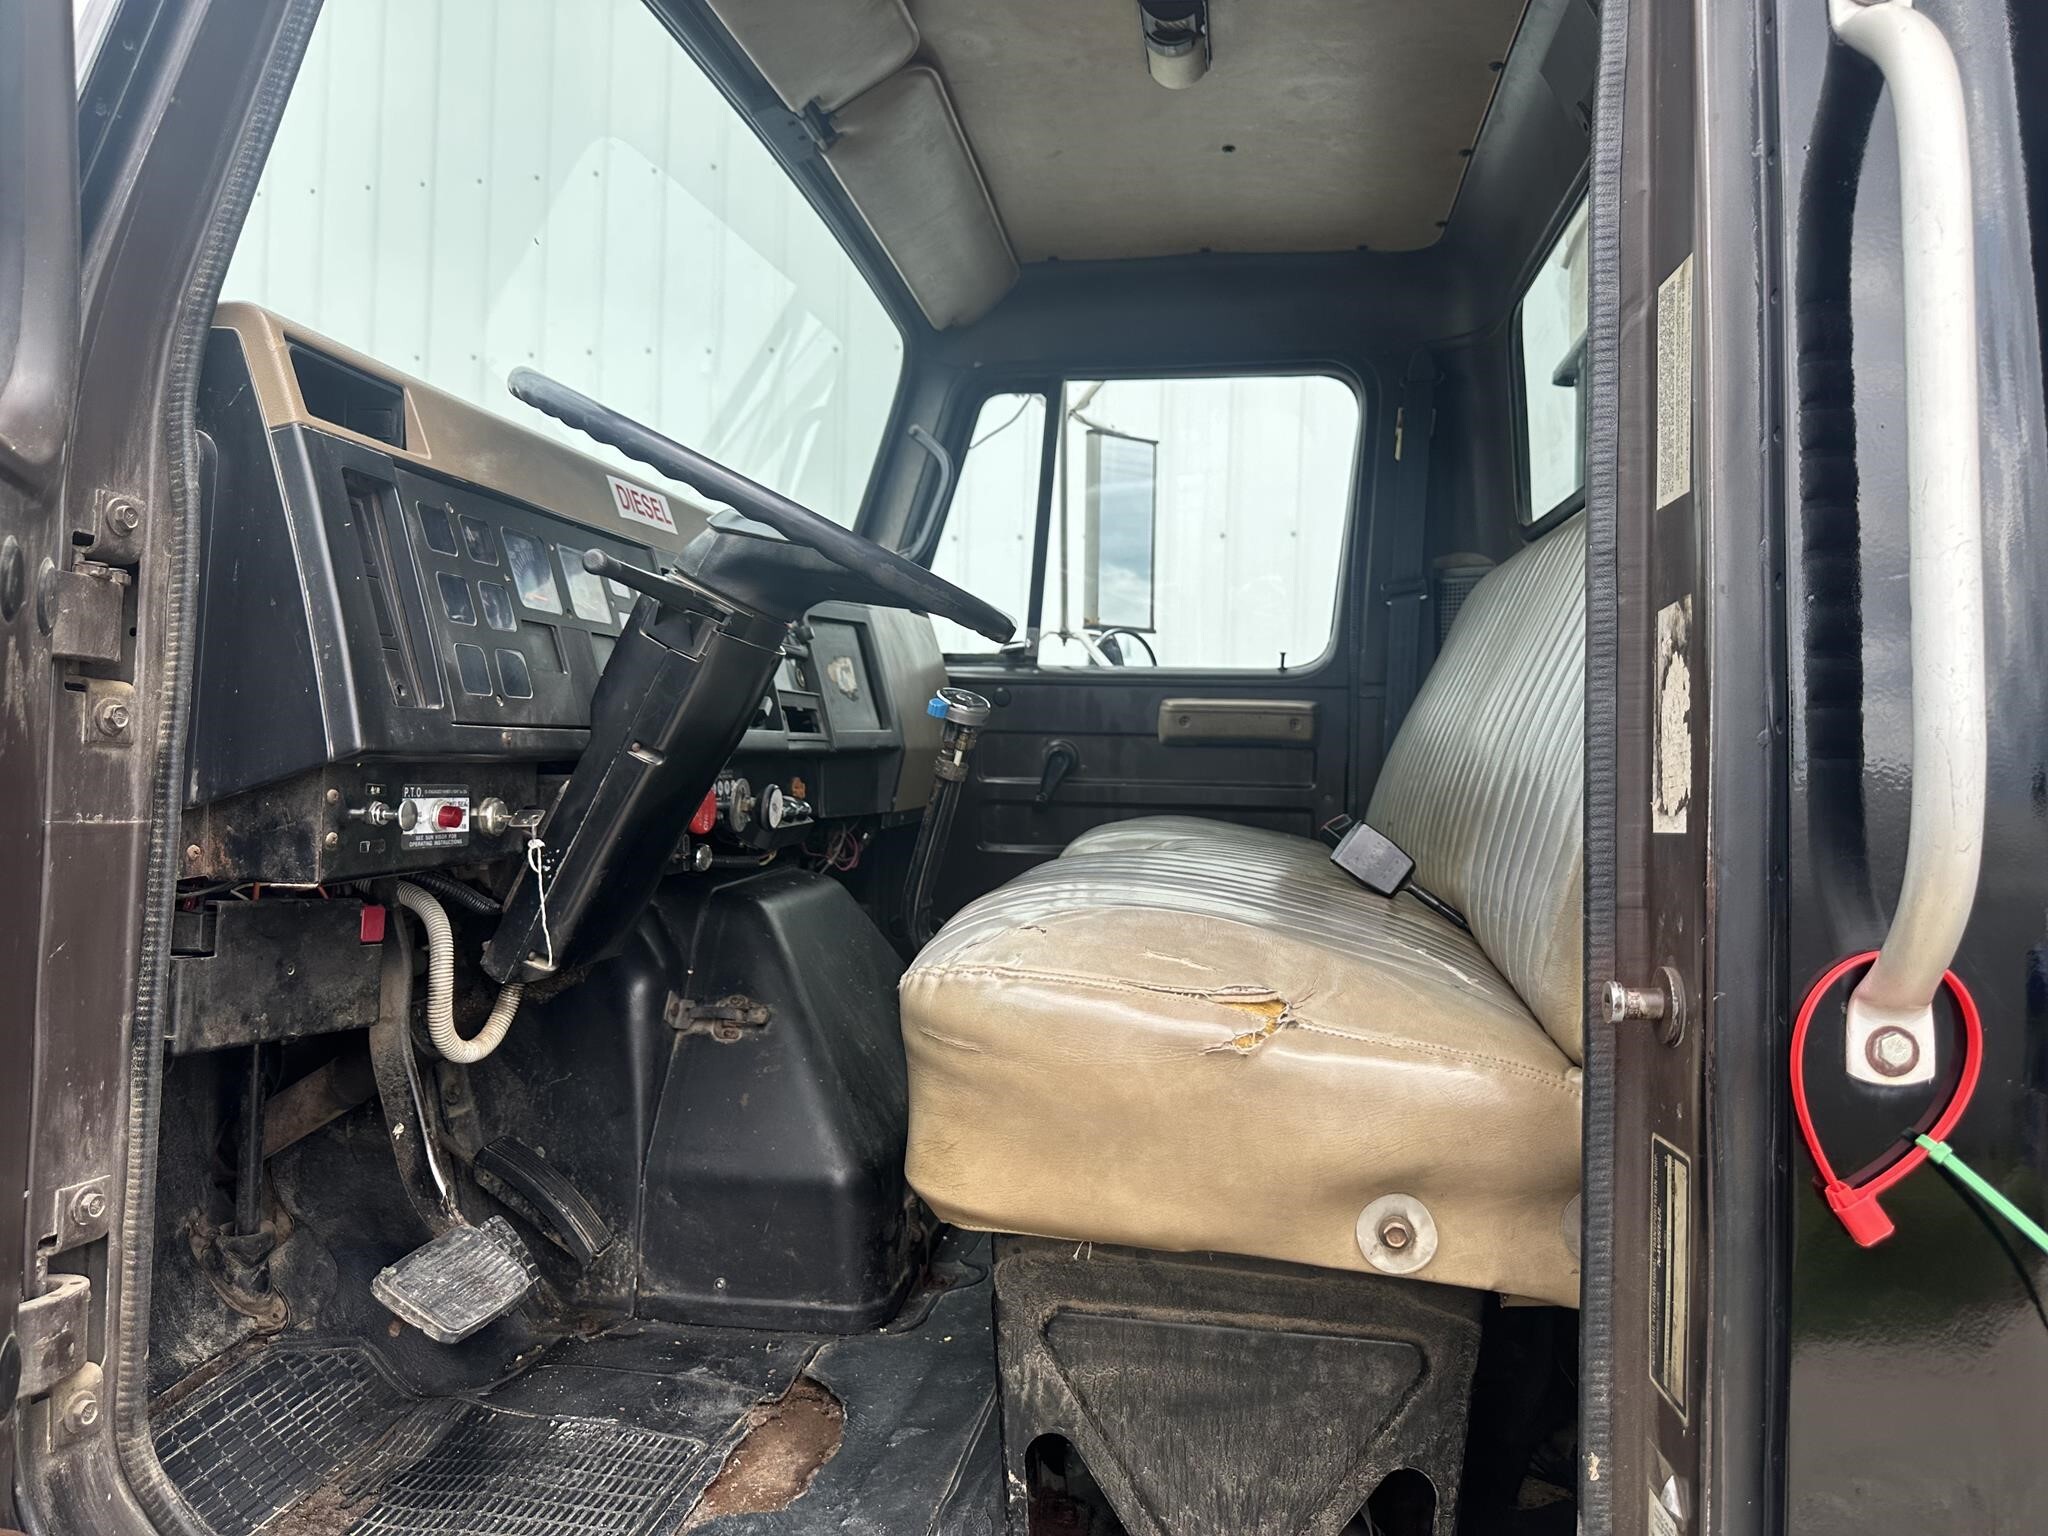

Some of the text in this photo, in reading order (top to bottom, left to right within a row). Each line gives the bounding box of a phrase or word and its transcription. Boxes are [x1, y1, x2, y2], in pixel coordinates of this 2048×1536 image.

[615, 483, 672, 525] DIESEL
[404, 787, 424, 797] P.T.O.
[409, 838, 463, 848] OPERATING INSTRUCTIONS
